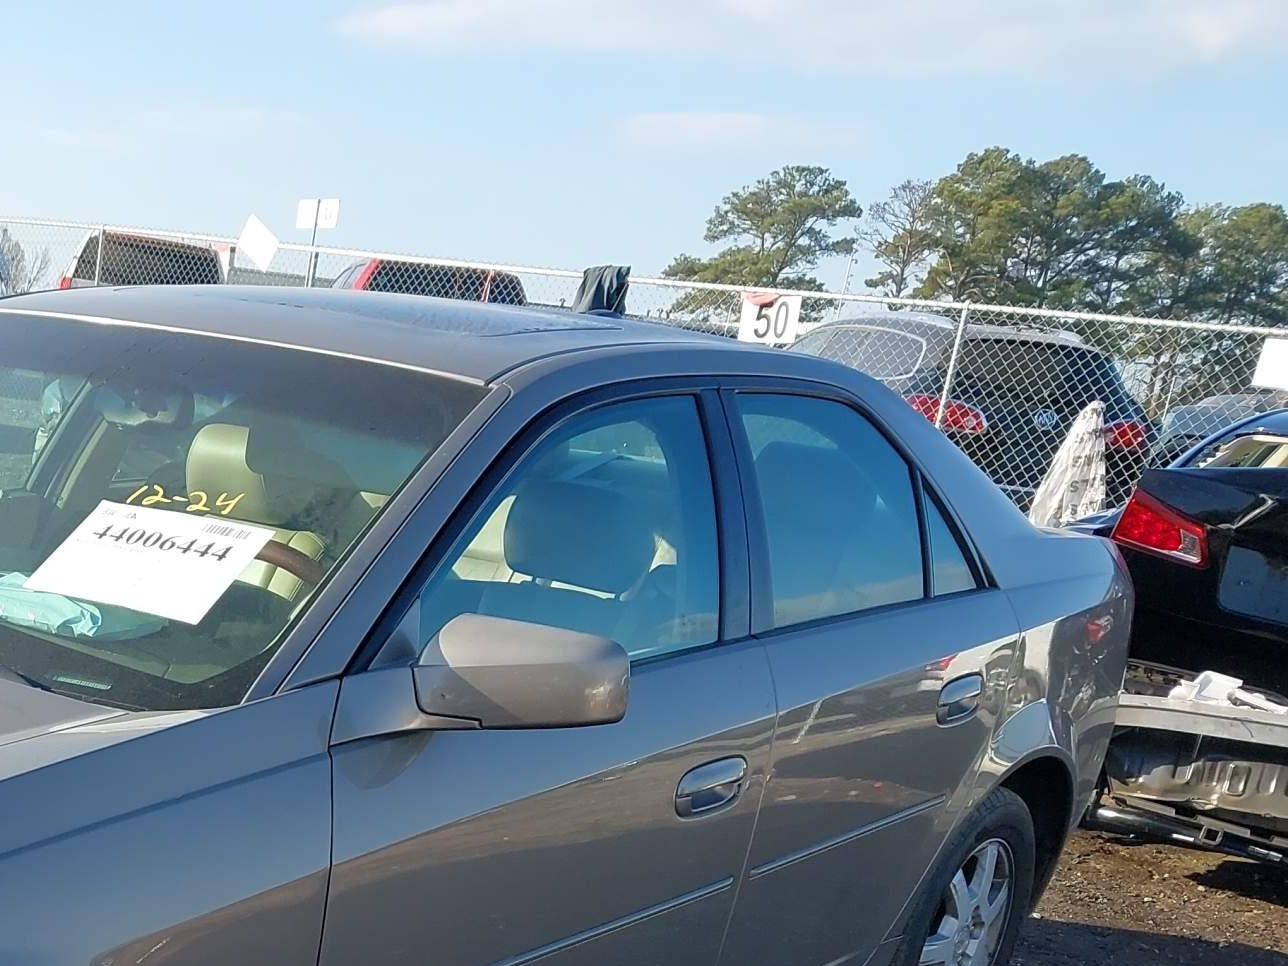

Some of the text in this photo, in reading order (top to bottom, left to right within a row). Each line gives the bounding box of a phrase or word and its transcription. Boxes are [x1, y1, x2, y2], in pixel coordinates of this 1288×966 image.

[753, 301, 789, 339] 50
[125, 484, 245, 515] 12-24
[92, 524, 234, 562] 44006444
